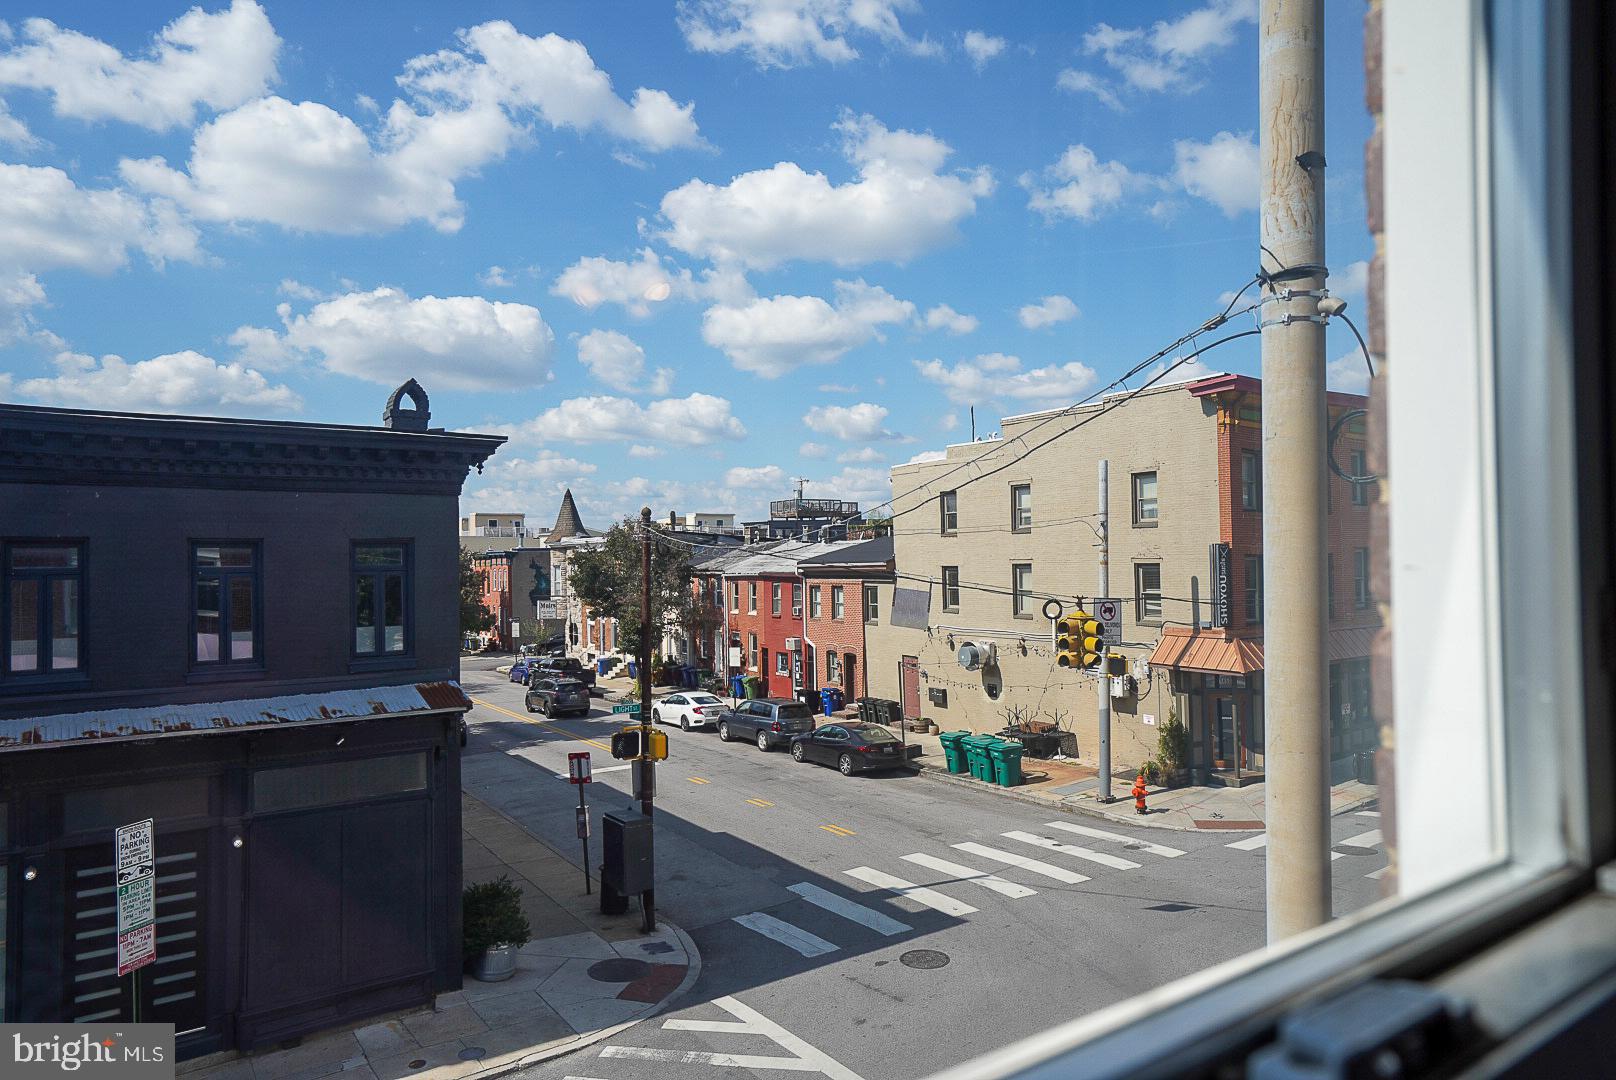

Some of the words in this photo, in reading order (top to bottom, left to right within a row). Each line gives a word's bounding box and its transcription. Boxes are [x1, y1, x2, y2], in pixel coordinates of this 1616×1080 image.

[1220, 575, 1228, 624] SHOYOU
[614, 705, 632, 714] LIGHT
[130, 831, 141, 840] NO
[120, 837, 150, 851] PARKING
[121, 887, 127, 895] 2
[130, 880, 150, 891] HOUR
[130, 925, 152, 939] PARKING
[139, 933, 152, 943] 7AM
